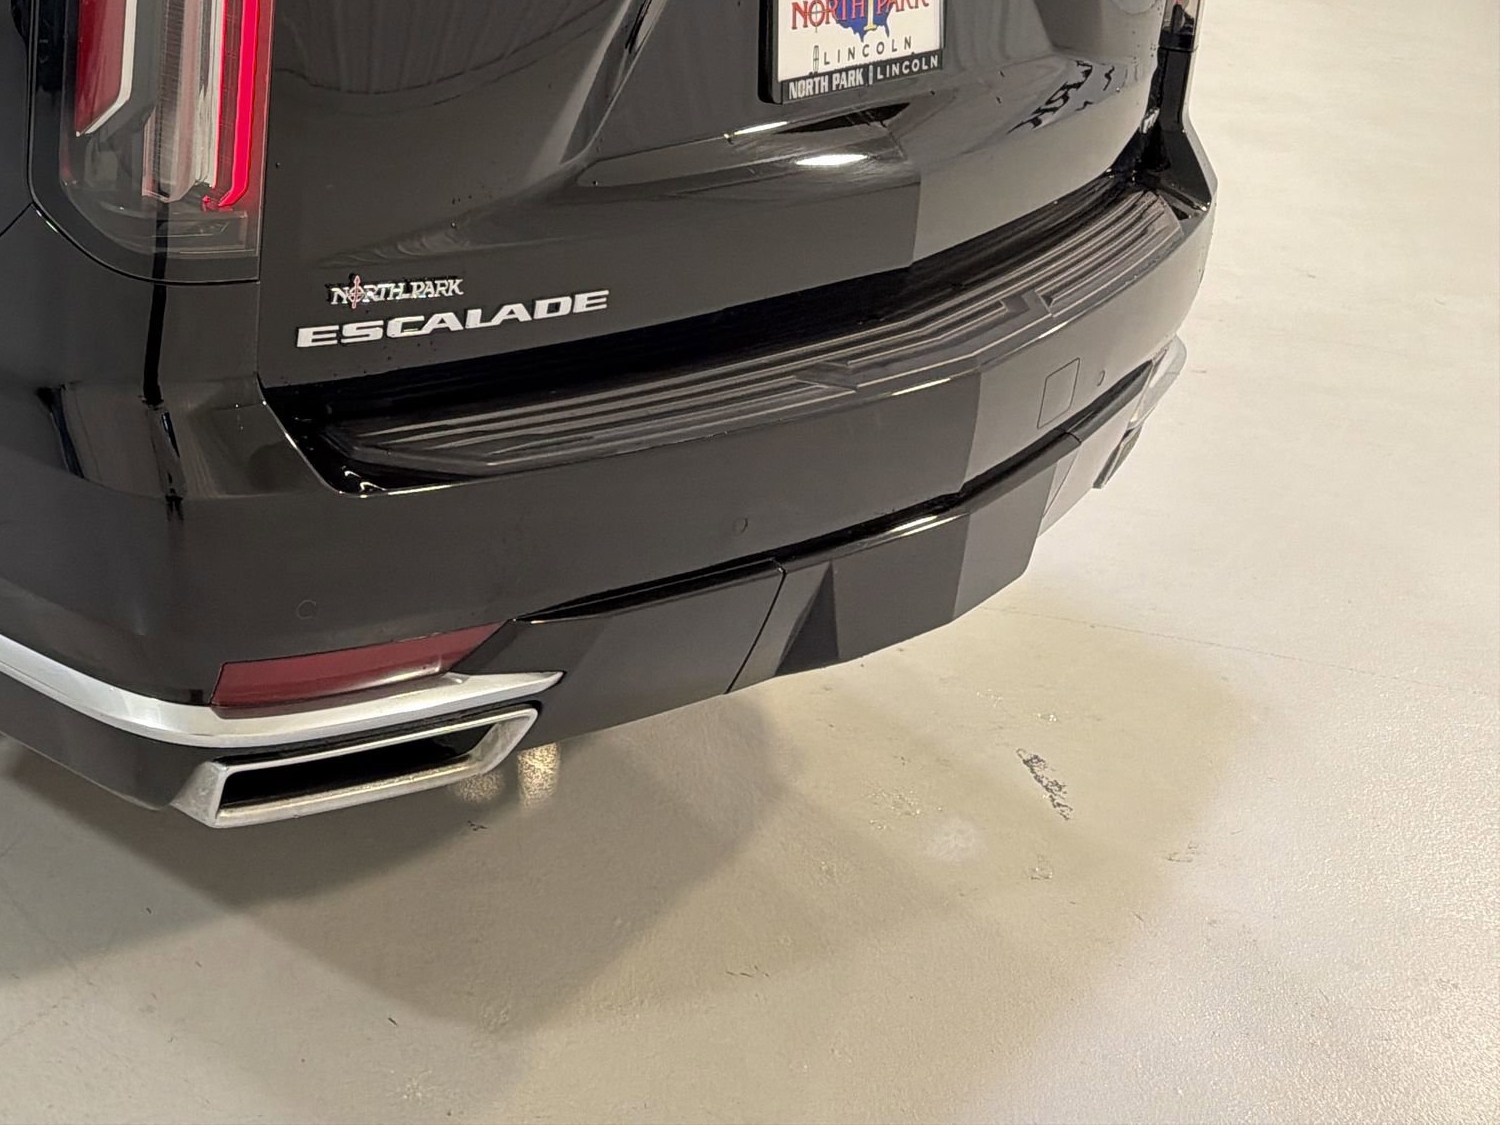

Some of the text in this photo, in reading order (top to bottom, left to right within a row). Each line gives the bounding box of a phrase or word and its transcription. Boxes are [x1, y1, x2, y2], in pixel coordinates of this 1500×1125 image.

[823, 35, 913, 66] LINCOLN
[788, 54, 939, 100] NORTH PARK LINCOLN
[330, 278, 465, 307] NORTH PARK
[296, 289, 610, 348] ESCALADE
